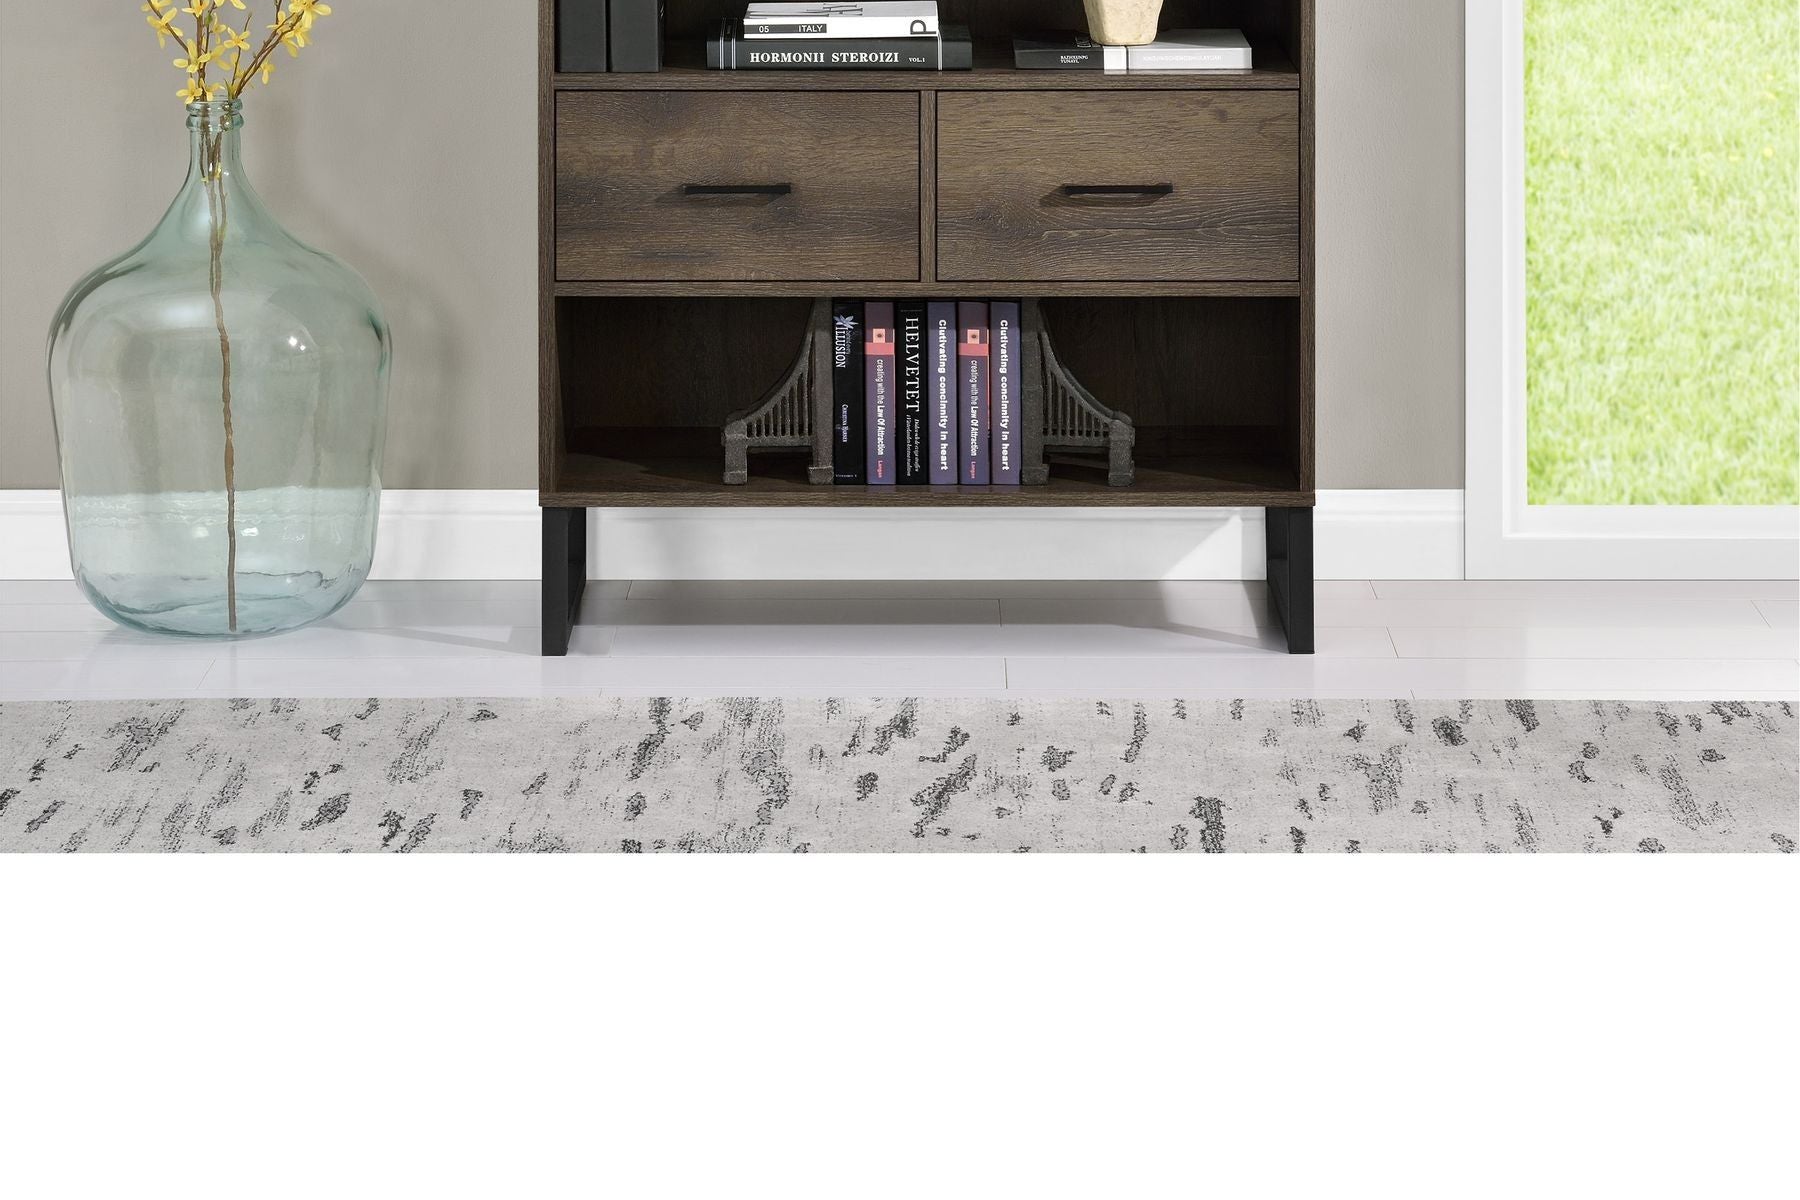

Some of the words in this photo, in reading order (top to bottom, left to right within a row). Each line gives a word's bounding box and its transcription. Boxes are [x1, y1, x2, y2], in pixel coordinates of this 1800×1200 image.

[758, 25, 770, 33] 05
[798, 24, 823, 33] ITALY
[749, 52, 825, 63] HORMONII
[831, 52, 900, 63] STEROIZI
[836, 327, 848, 368] ILLUSION
[937, 319, 947, 374] Clutivating
[999, 319, 1009, 374] Clutivating
[875, 359, 885, 382] creating
[905, 317, 920, 412] HELVETET
[969, 360, 979, 383] creating
[877, 383, 885, 394] with
[971, 384, 979, 395] with
[877, 395, 885, 404] the
[938, 376, 948, 429] concinnity
[971, 396, 979, 405] the
[1000, 376, 1010, 429] concinnity
[877, 405, 885, 417] Law
[971, 406, 979, 418] Law
[877, 418, 885, 426] Of
[971, 419, 979, 427] Of
[877, 426, 885, 456] Attraction
[940, 430, 948, 441] in
[971, 427, 979, 457] Attraction
[1001, 430, 1010, 441] in
[940, 443, 948, 471] heart
[1001, 443, 1010, 471] heart
